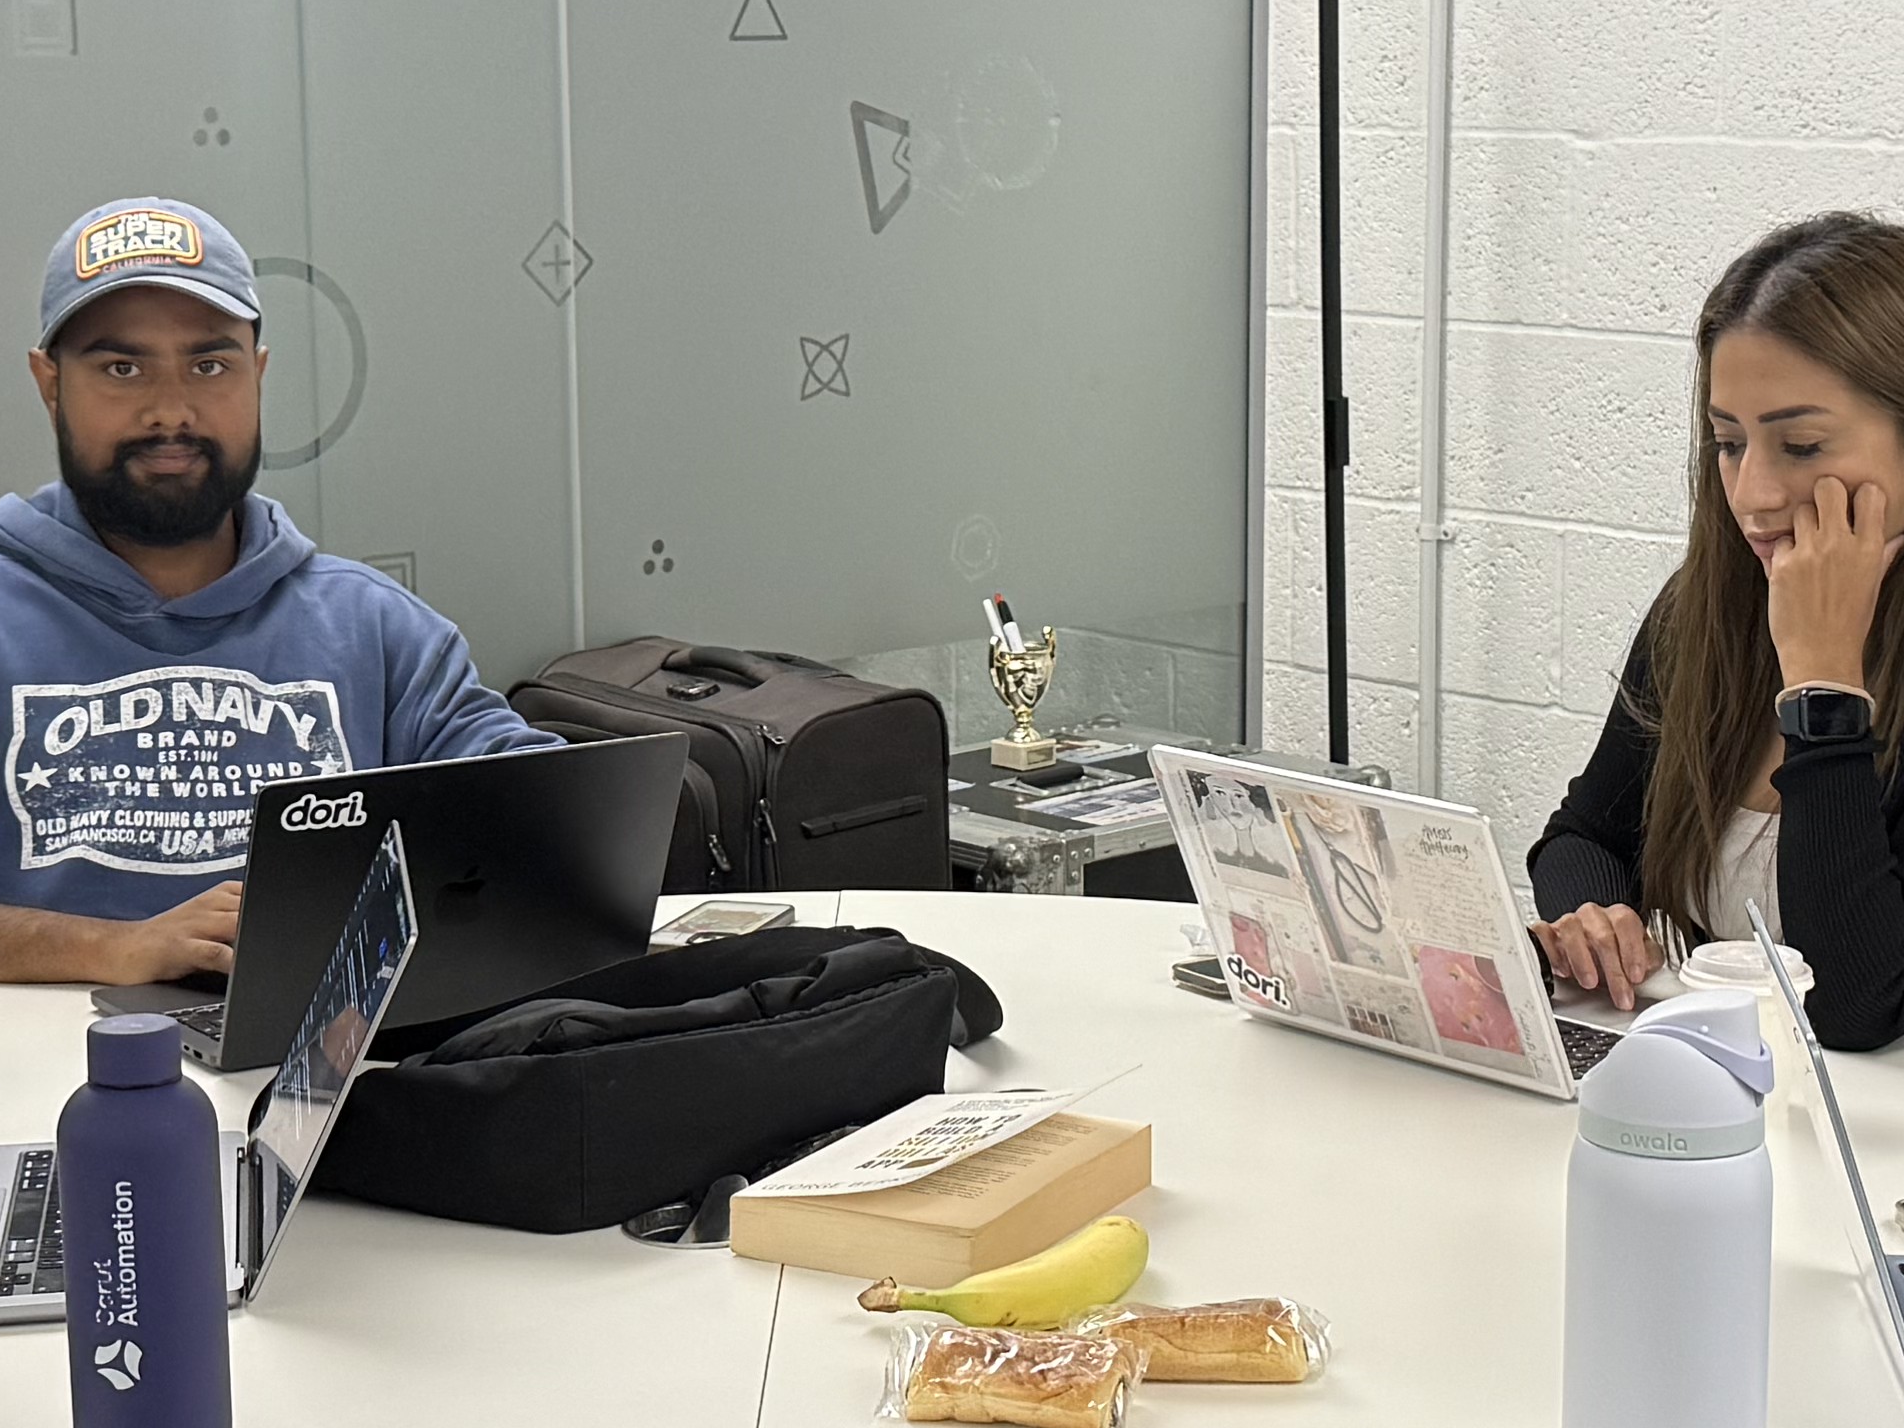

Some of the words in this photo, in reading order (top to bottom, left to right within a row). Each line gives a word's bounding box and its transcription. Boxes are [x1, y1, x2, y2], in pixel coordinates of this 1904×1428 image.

[90, 220, 183, 245] SUPER
[90, 234, 183, 261] TRACK
[44, 687, 163, 756] OLD
[172, 682, 317, 751] NAVY
[137, 730, 237, 749] BRAND
[68, 764, 178, 783] KNOWN
[189, 761, 303, 781] AROUND
[104, 781, 160, 797] THE
[36, 818, 67, 836] OLD
[69, 810, 111, 830] NAVY
[114, 809, 190, 828] CLOTHING
[193, 811, 206, 828] &
[208, 807, 255, 828] SUPPL
[284, 794, 365, 828] dori.
[161, 830, 216, 856] USA
[1226, 955, 1288, 1007] dori.
[934, 1115, 990, 1127] HOW
[994, 1113, 1023, 1125] TO
[1619, 1132, 1688, 1152] owala
[111, 1180, 139, 1327] Automation
